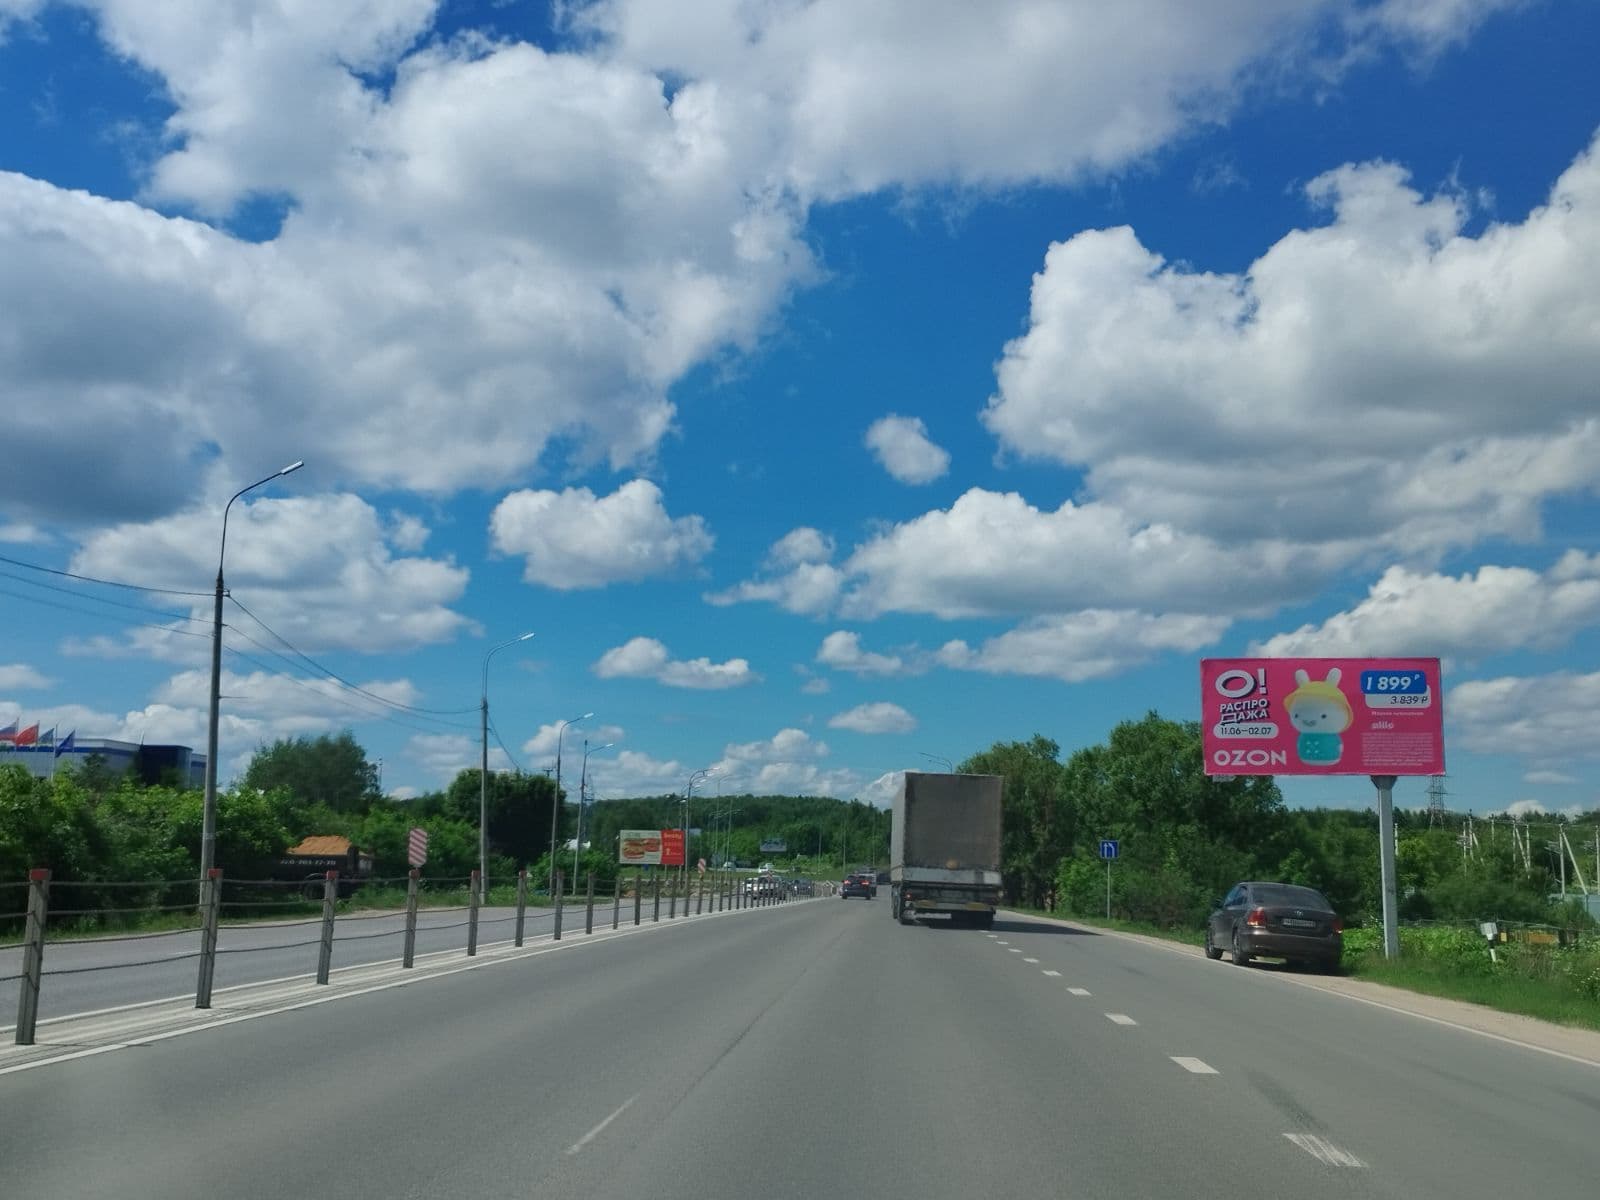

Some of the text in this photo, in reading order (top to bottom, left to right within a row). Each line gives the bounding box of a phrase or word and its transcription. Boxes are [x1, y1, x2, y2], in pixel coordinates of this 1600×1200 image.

[1377, 676, 1412, 690] 899
[1220, 698, 1268, 713] РАСПРО
[1400, 695, 1418, 704] 839
[1220, 709, 1268, 724] ДАЖА
[1213, 749, 1287, 766] OZON
